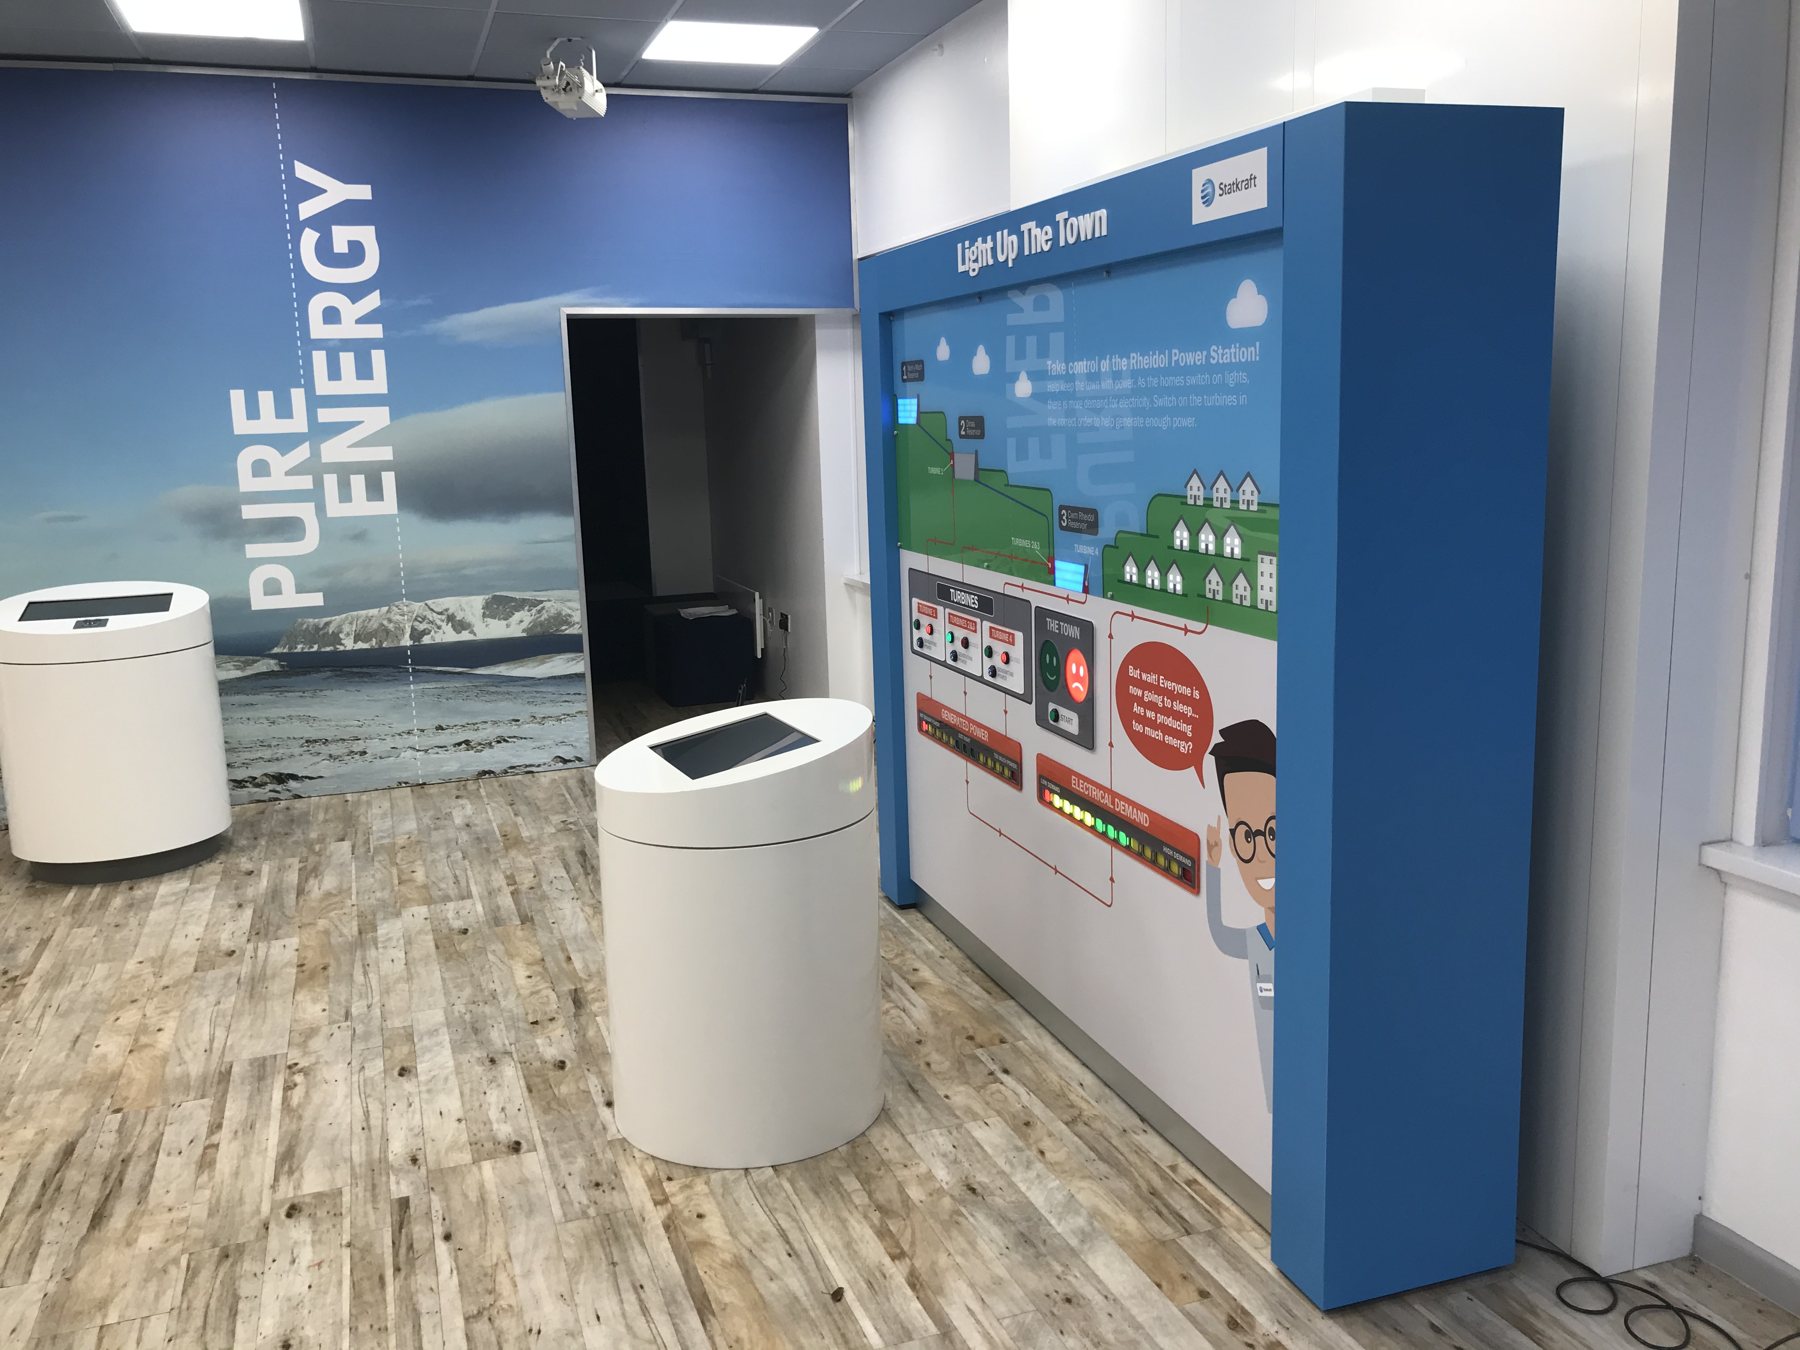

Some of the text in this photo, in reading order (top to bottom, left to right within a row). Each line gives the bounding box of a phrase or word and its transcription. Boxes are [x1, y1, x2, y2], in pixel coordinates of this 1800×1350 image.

[1218, 173, 1257, 197] Statkraft
[957, 208, 1108, 277] Light Up The Town
[294, 160, 398, 517] ENERGY
[1047, 341, 1260, 376] Take control of the Rheidol Power Station!
[902, 365, 907, 379] 1
[1138, 376, 1146, 388] As
[1147, 375, 1158, 388] the
[1160, 375, 1184, 387] homes
[1186, 372, 1211, 386] switch
[1212, 373, 1222, 385] on
[1225, 370, 1249, 387] lights,
[1109, 396, 1118, 408] for
[1153, 394, 1176, 408] Switch
[1178, 396, 1188, 407] on
[1190, 393, 1202, 407] the
[1203, 392, 1237, 406] turbines
[1239, 391, 1247, 405] in
[960, 420, 966, 435] 2
[1115, 416, 1144, 430] generate
[1145, 415, 1171, 430] enough
[1172, 416, 1197, 429] power.
[230, 387, 324, 610] PURE
[1061, 509, 1067, 527] 3
[1079, 512, 1095, 522] Rheidol
[1011, 537, 1031, 549] TURBINES
[1074, 544, 1094, 556] TURBINE
[949, 588, 979, 609] TURBINES
[949, 614, 967, 628] TURBINES
[1046, 618, 1080, 640] THE TOWN
[991, 628, 1009, 643] TURBINE
[1128, 665, 1200, 700] But wait! Everyone is
[1129, 685, 1199, 719] now going to sleep...
[941, 708, 970, 732] GENERATED
[969, 723, 989, 742] POWER
[1060, 713, 1073, 726] START
[1133, 702, 1193, 737] Are we producing
[1132, 719, 1193, 754] too much energy?
[1071, 775, 1150, 827] ELECTRICAL DEMAND
[1162, 845, 1192, 867] HIGH DEMAND
